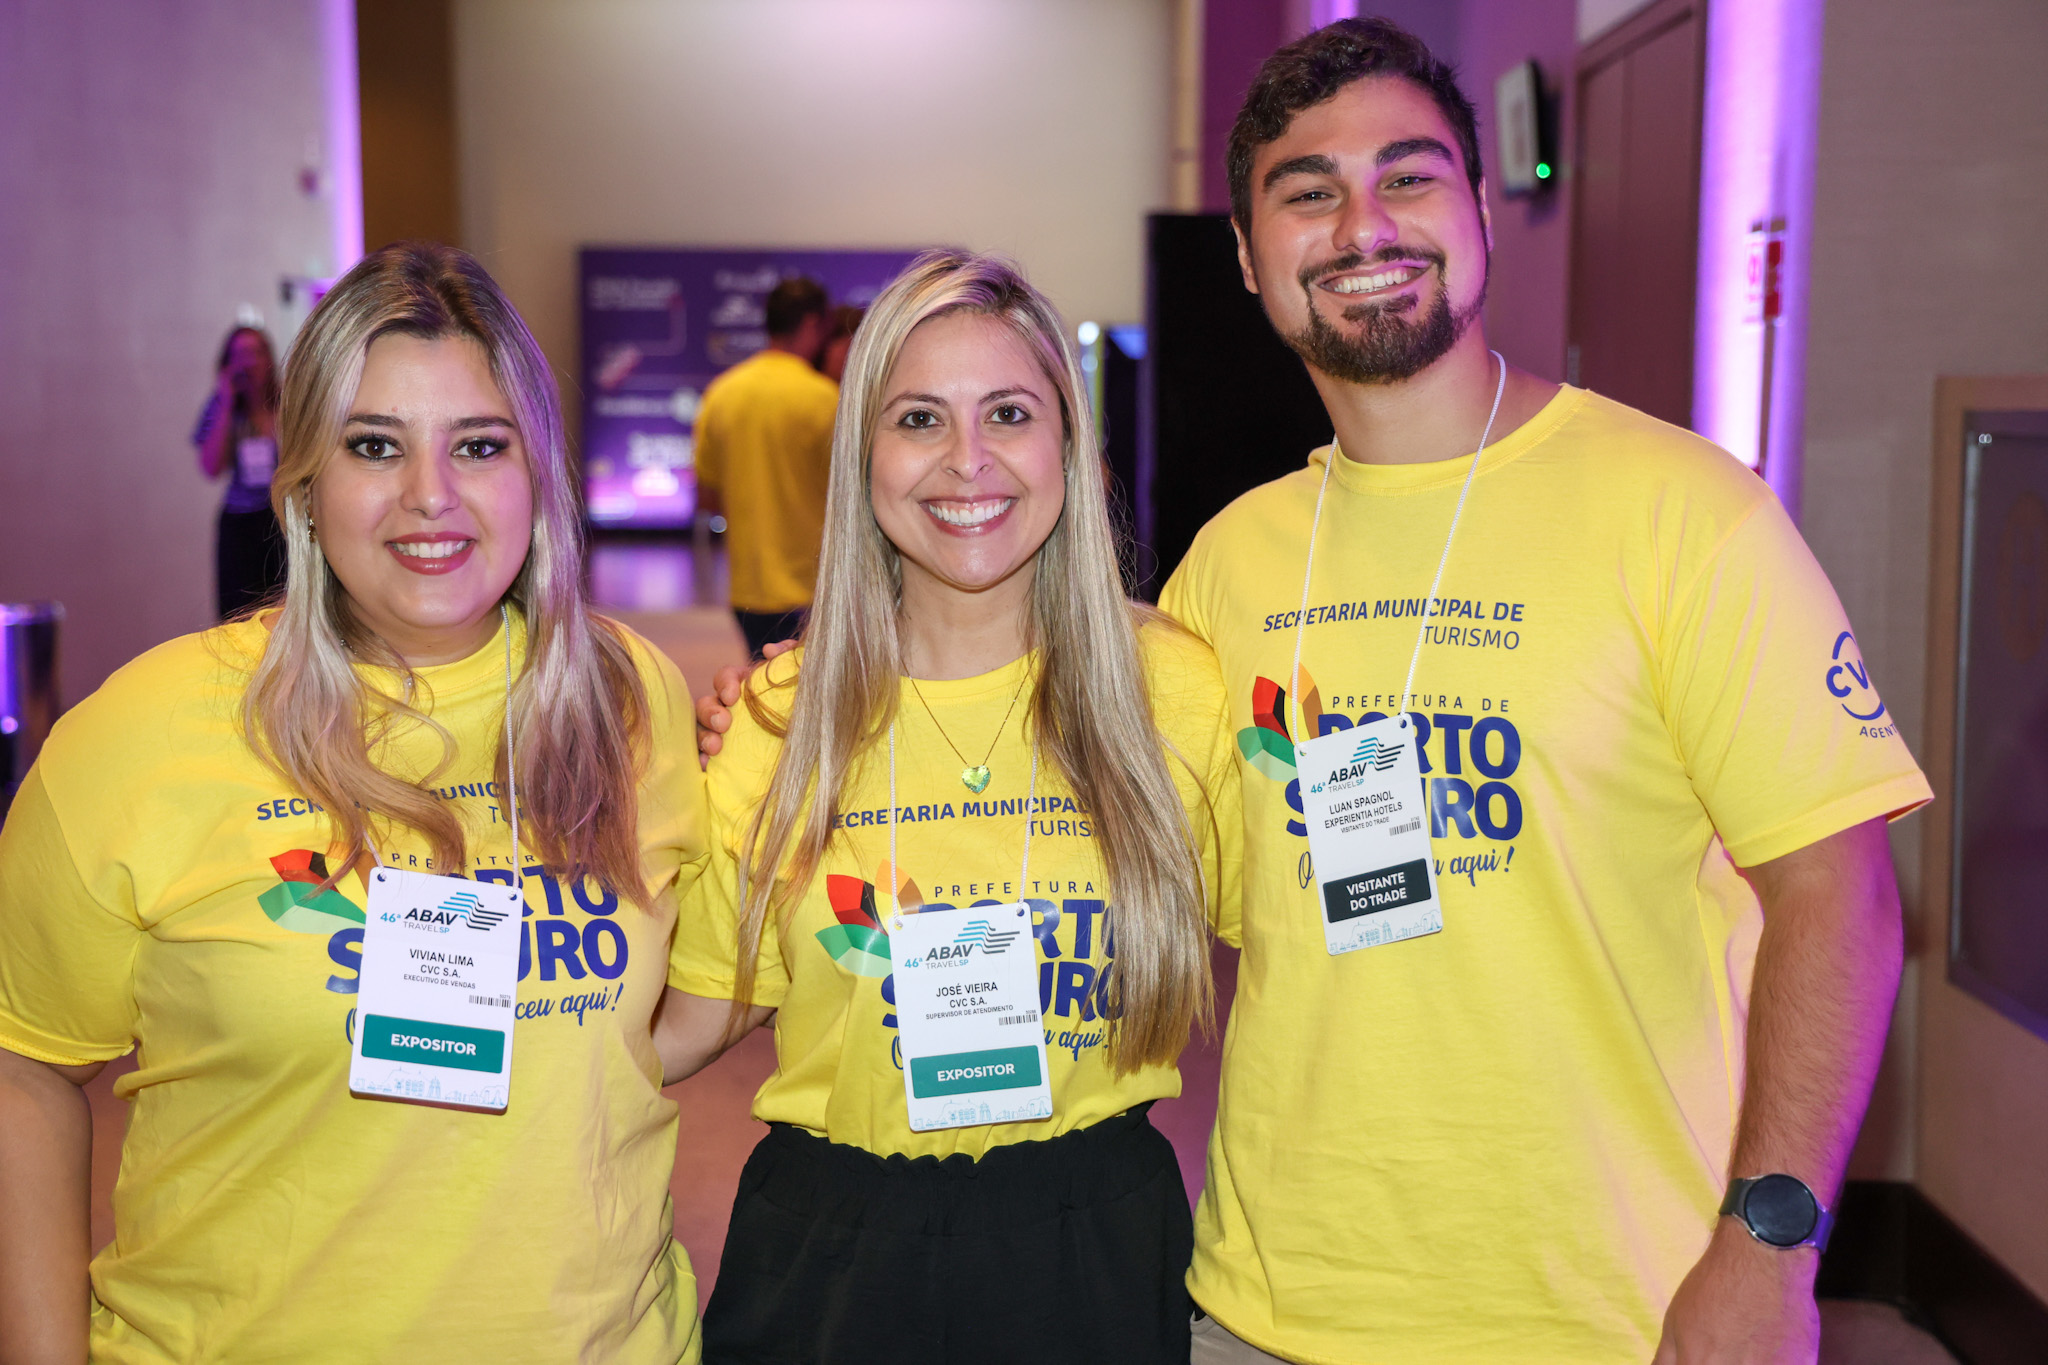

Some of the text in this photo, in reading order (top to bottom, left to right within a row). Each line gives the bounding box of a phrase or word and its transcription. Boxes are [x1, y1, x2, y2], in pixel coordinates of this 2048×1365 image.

[1263, 598, 1525, 632] SECRETARIA MUNICIPAL DE
[1424, 626, 1520, 650] TURISMO
[1333, 694, 1509, 713] PREFETURA DE
[1859, 723, 1898, 739] AGENT
[1328, 762, 1368, 785] ABAV
[1329, 790, 1394, 815] LUAN SPAGNOL
[831, 803, 956, 829] ECRETARIA
[1324, 801, 1403, 829] EXPERIENTIA HOTELS
[1030, 820, 1092, 837] TURIS
[1340, 816, 1390, 834] VISITANTE DO TRADE
[1450, 846, 1515, 887] aqui!
[934, 881, 1095, 898] PREFETURA
[1346, 871, 1406, 896] VISITANTE
[1350, 887, 1408, 911] DO TRADE
[404, 907, 459, 926] ABAV
[409, 948, 474, 967] VIVIAN LIMA
[925, 943, 974, 961] ABAV
[420, 964, 461, 978] CVC S.A.
[403, 973, 440, 985] EXECUTIVO
[450, 980, 476, 989] VENDAS
[936, 981, 998, 997] JOSÉ VIEIRA
[560, 982, 624, 1027] aqui!
[949, 996, 987, 1008] CVC S.A.
[925, 1010, 963, 1020] SUPERVISOR
[972, 1005, 1014, 1015] ATENDIMENTO
[390, 1033, 477, 1056] EXPOSITOR
[937, 1063, 1016, 1082] EXPOSITOR
